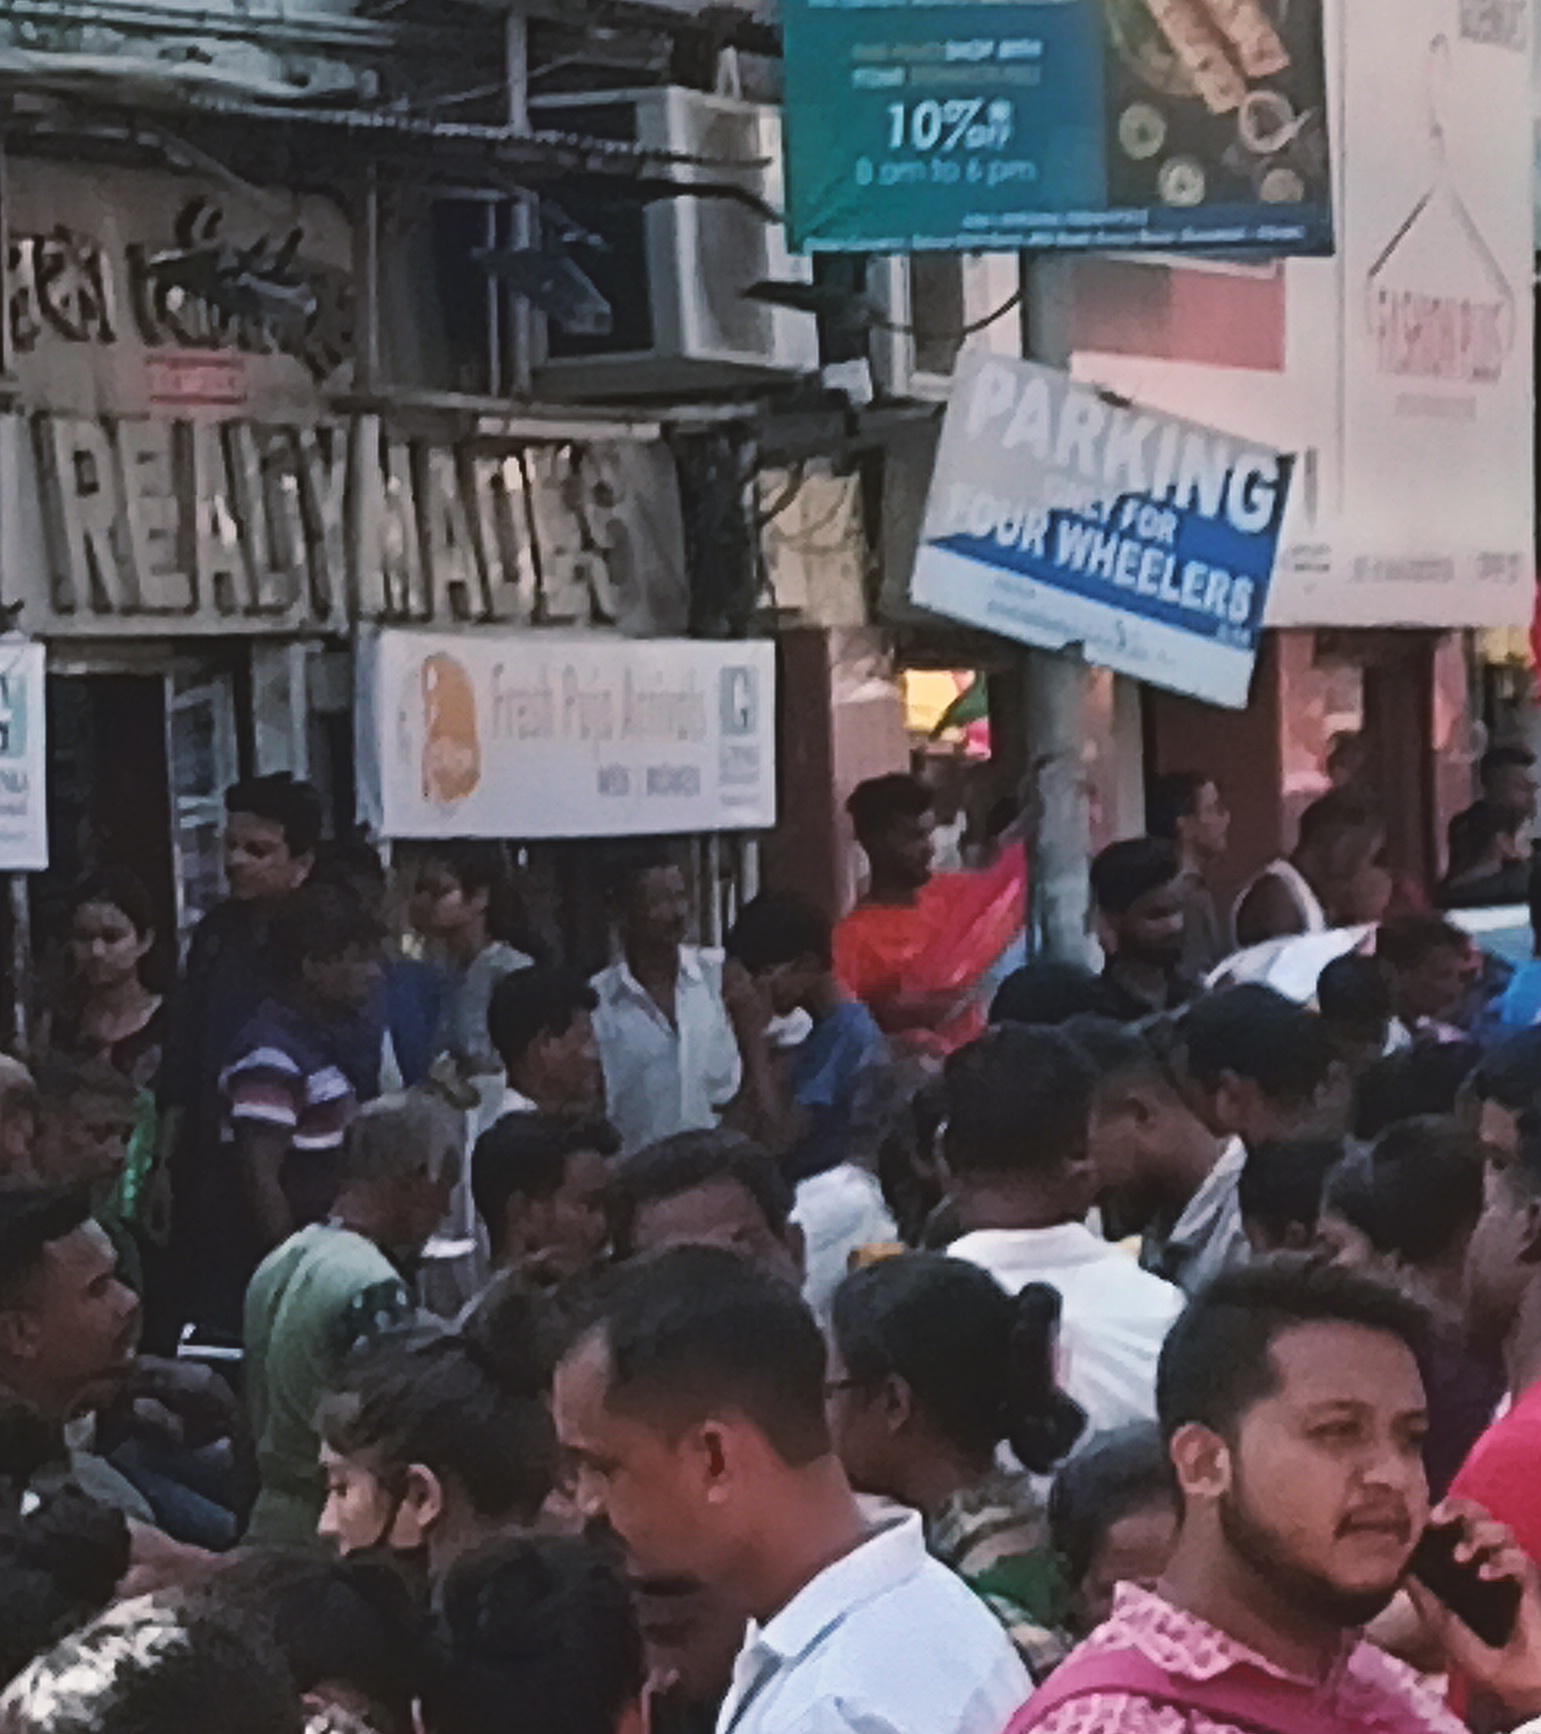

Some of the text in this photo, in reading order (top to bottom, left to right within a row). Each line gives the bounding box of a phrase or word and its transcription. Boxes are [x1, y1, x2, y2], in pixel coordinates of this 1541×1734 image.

[966, 360, 1280, 535] PARKING
[1052, 518, 1255, 625] WHEELERS
[1117, 497, 1178, 545] FOR
